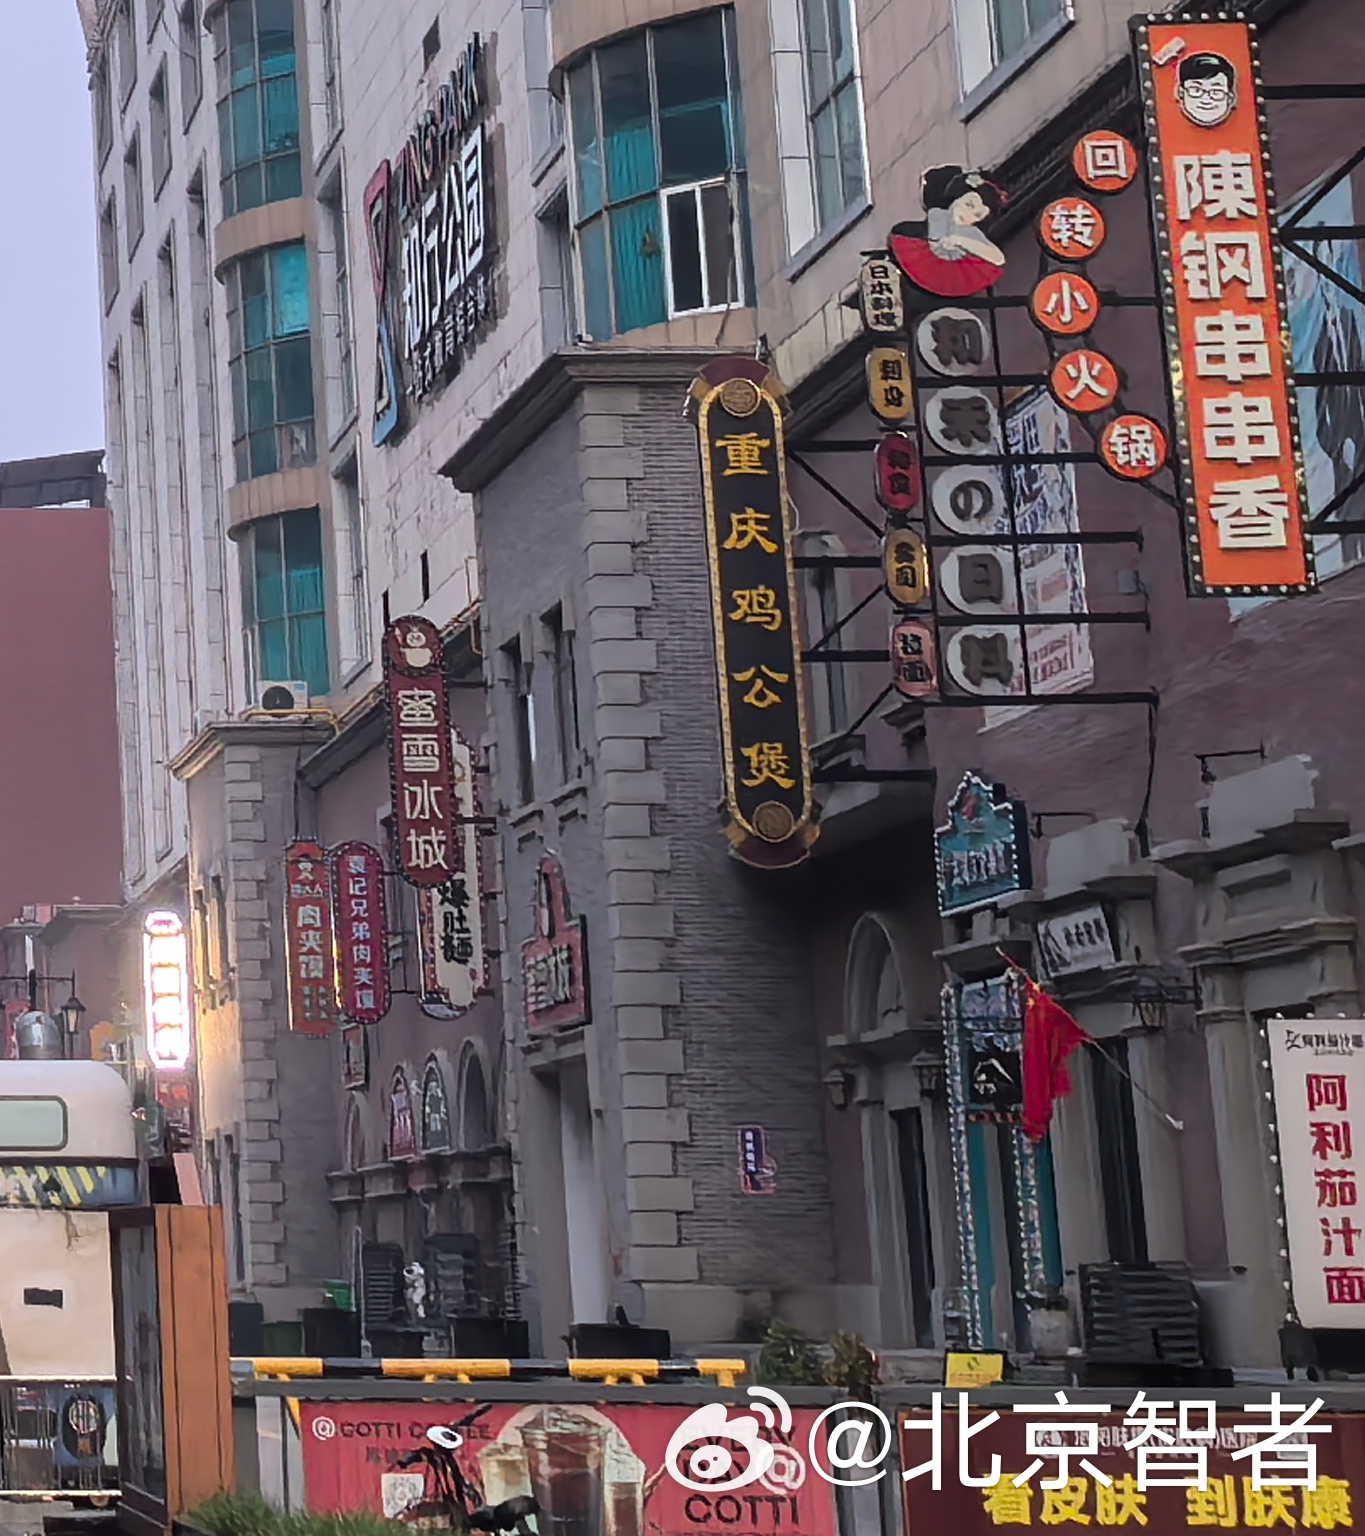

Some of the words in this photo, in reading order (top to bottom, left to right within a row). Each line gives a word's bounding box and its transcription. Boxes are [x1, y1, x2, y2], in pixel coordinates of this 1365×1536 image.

[1044, 140, 1165, 468] 回转小火锅
[1172, 150, 1288, 550] 陳钢串串香
[715, 431, 796, 791] 重庆鸡公煲
[397, 687, 450, 870] 蜜雪冰城
[1306, 1073, 1365, 1305] 阿利茄汁面
[684, 1494, 799, 1528] COTTI
